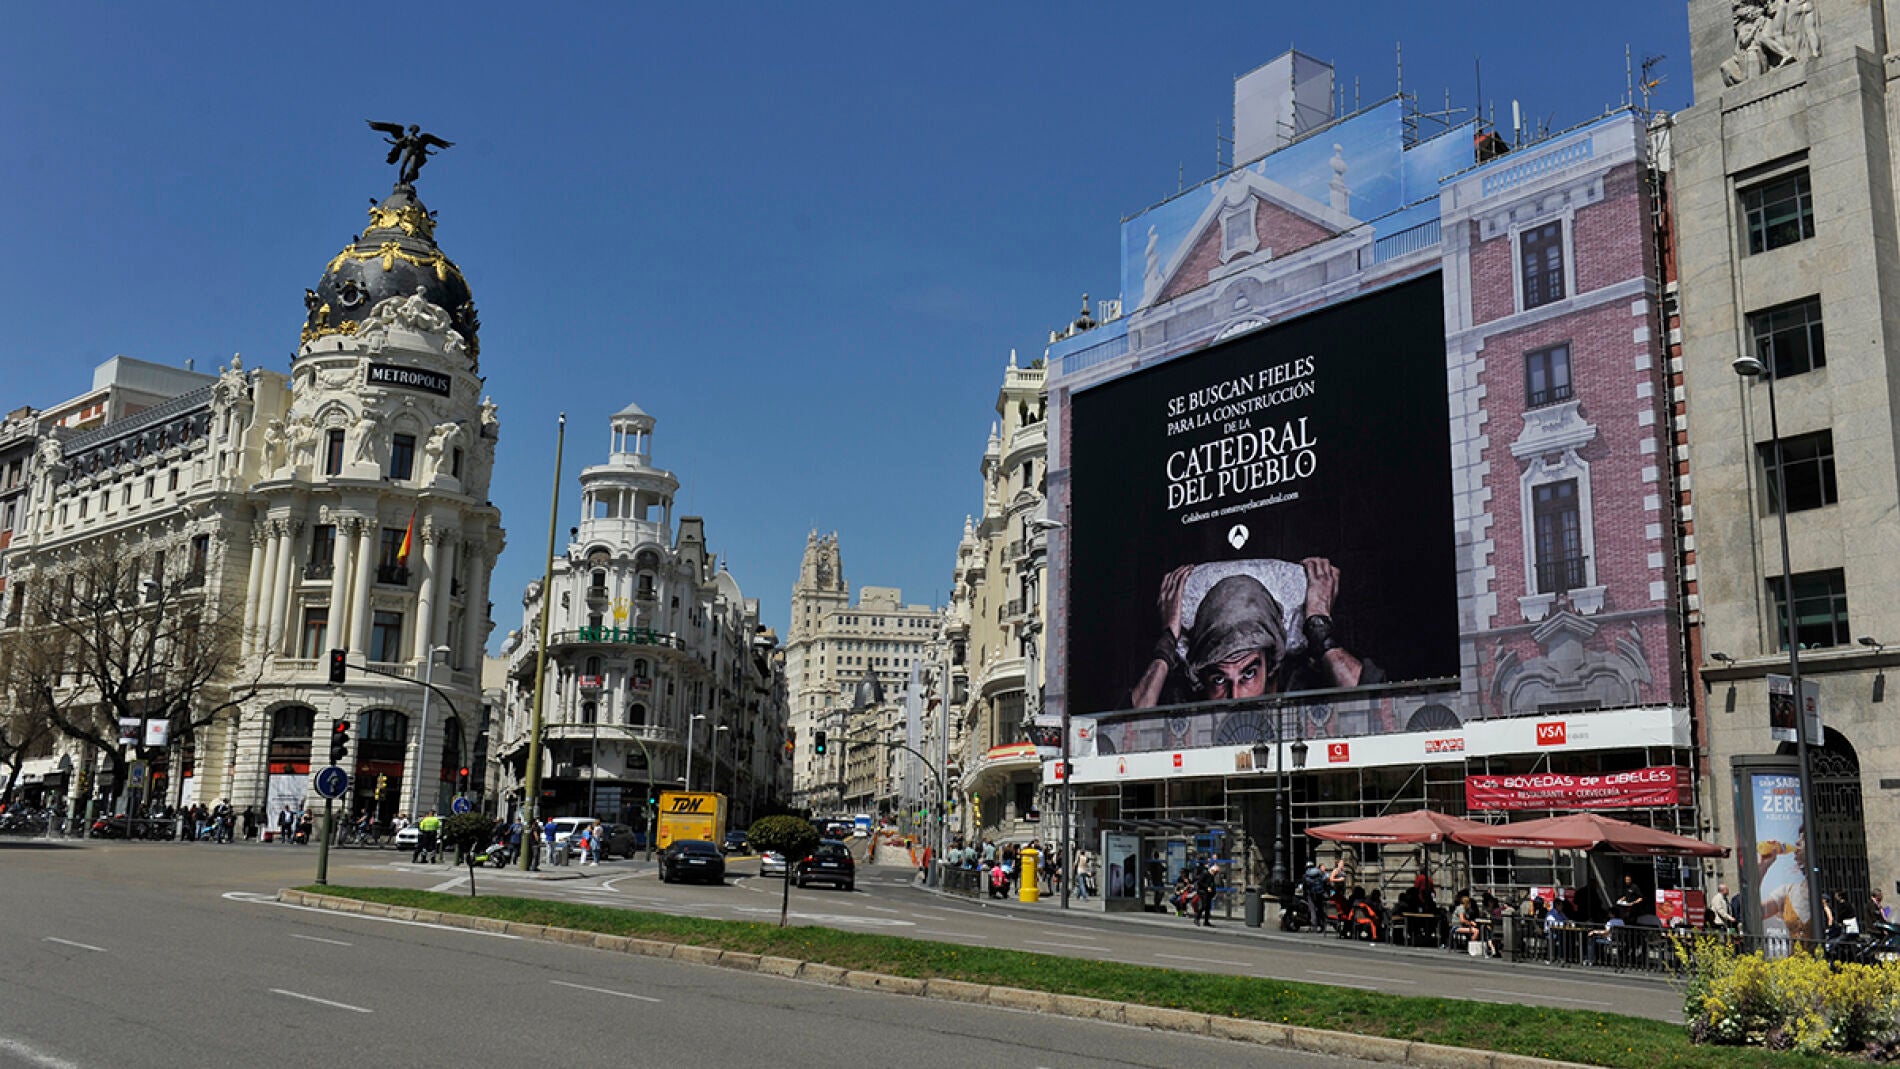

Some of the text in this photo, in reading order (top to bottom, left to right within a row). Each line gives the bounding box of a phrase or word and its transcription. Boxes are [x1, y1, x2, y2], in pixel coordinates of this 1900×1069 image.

[371, 368, 447, 391] METROPOLIS
[1167, 354, 1316, 417] SE BUSCAN FIELES
[1167, 379, 1316, 436] PARA LA CONSTRUCCIÓN
[1223, 416, 1252, 434] DE LA
[1166, 415, 1318, 482] CATEDRAL
[1167, 449, 1317, 511] DEL PUEBLO
[579, 625, 658, 644] ROLEX
[1538, 725, 1564, 738] VSA
[1503, 776, 1574, 788] BÓVEDAS
[1605, 770, 1671, 785] CIBELES
[672, 797, 704, 812] TDN
